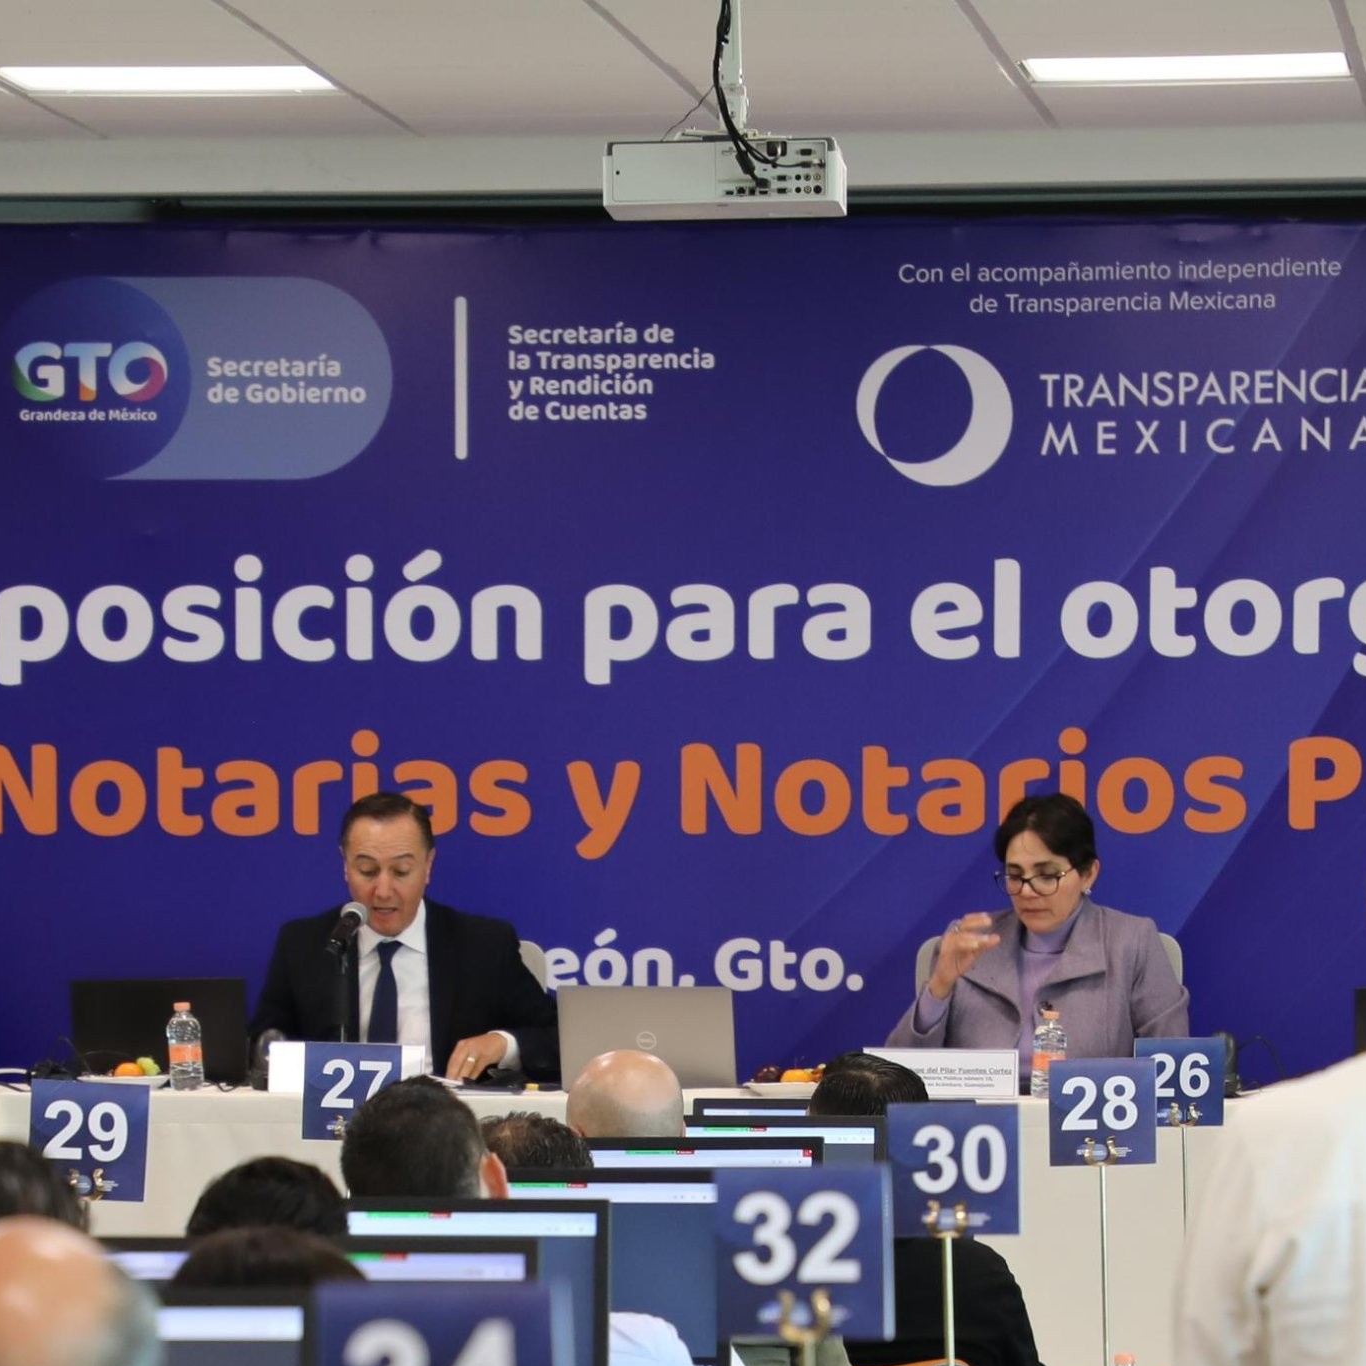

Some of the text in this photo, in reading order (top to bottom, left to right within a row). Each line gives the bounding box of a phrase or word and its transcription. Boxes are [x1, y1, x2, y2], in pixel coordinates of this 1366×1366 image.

[898, 257, 1342, 286] Con el acompañamiento independiente
[969, 291, 1276, 318] de Transparencia Mexicana
[508, 321, 675, 345] Secretaría de
[11, 341, 169, 403] GTO
[207, 353, 341, 378] Secretaría
[508, 348, 715, 377] la Transparencia
[508, 371, 653, 398] y Rendición
[19, 406, 158, 422] Grandeza de México
[207, 380, 367, 404] de Gobierno
[508, 400, 647, 421] de Cuentas
[583, 582, 873, 686] para
[909, 558, 1022, 660] el
[567, 761, 641, 860] y
[680, 727, 1248, 836] Notarios
[714, 937, 864, 992] Gto.
[320, 1058, 393, 1109] 27
[1155, 1052, 1210, 1098] 26
[1060, 1075, 1138, 1131] 28
[43, 1099, 129, 1162] 29
[911, 1124, 1008, 1194] 30
[733, 1190, 862, 1285] 32
